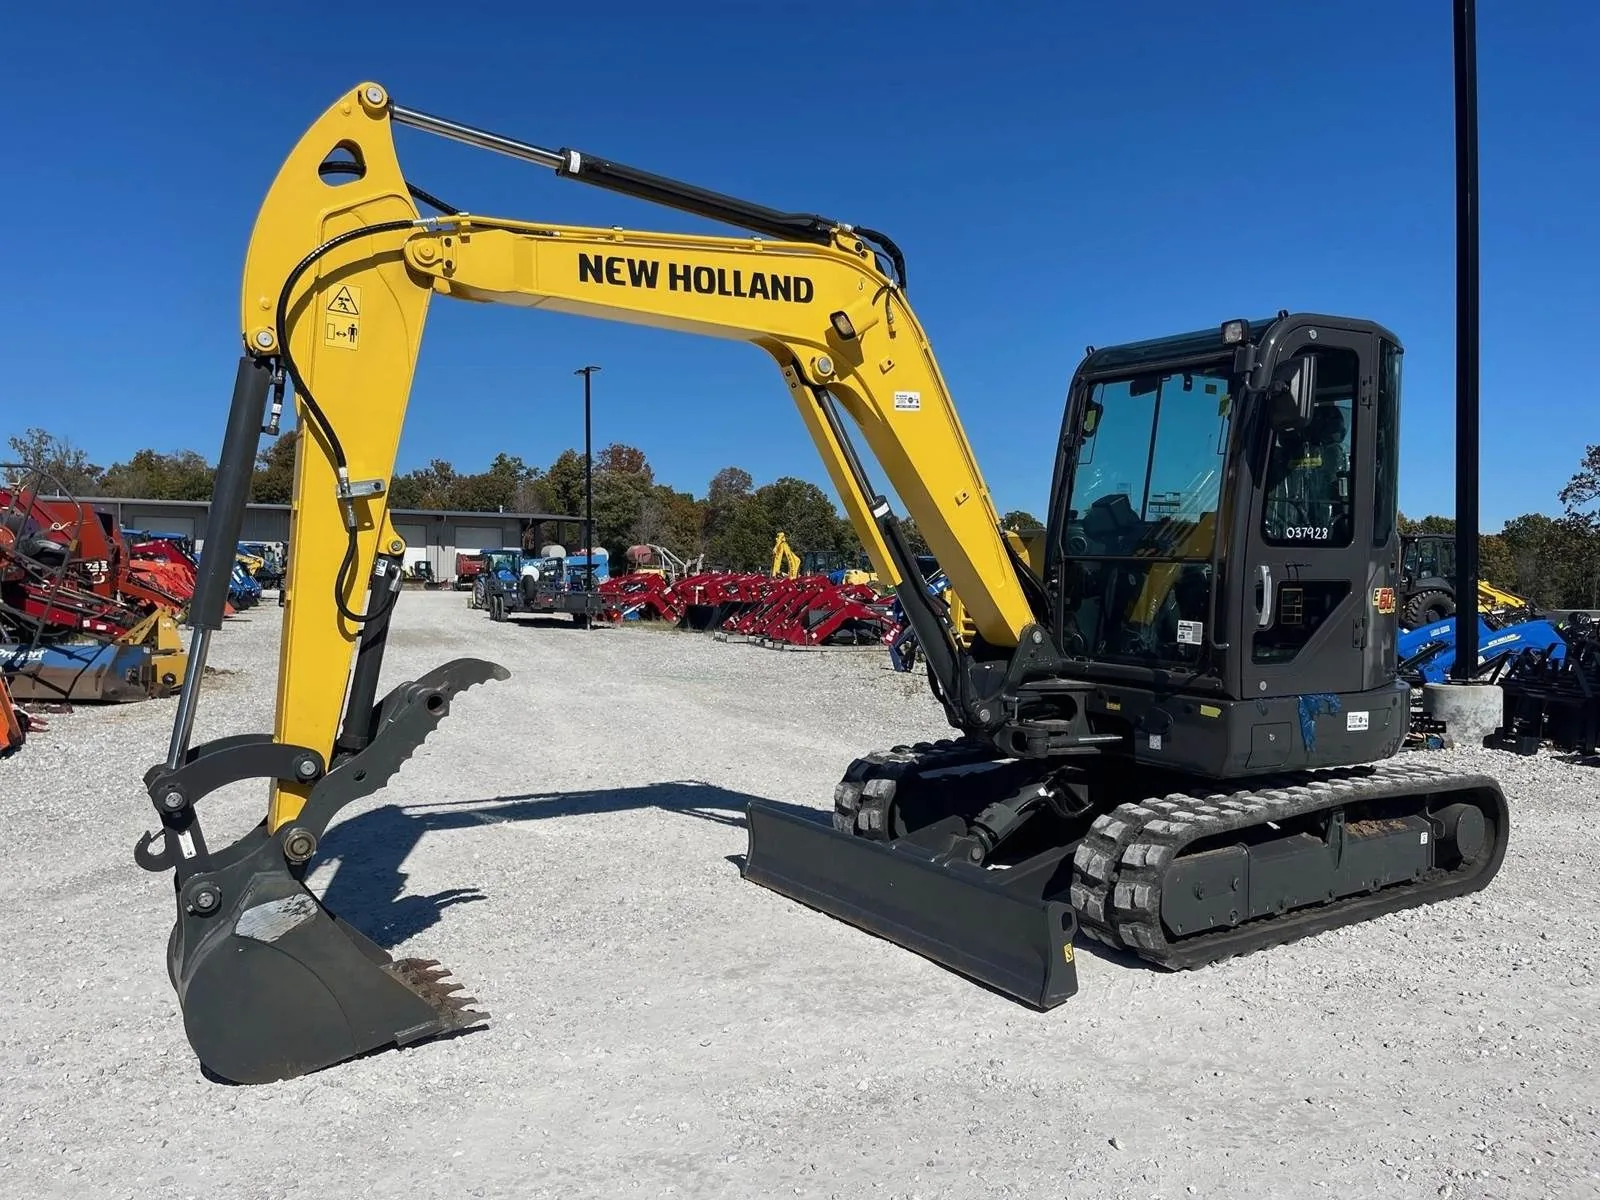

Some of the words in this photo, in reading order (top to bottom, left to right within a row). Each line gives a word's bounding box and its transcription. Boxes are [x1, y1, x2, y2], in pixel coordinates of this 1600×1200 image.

[578, 253, 659, 289] NEW
[669, 263, 814, 303] HOLLAND
[1286, 526, 1329, 540] 037928
